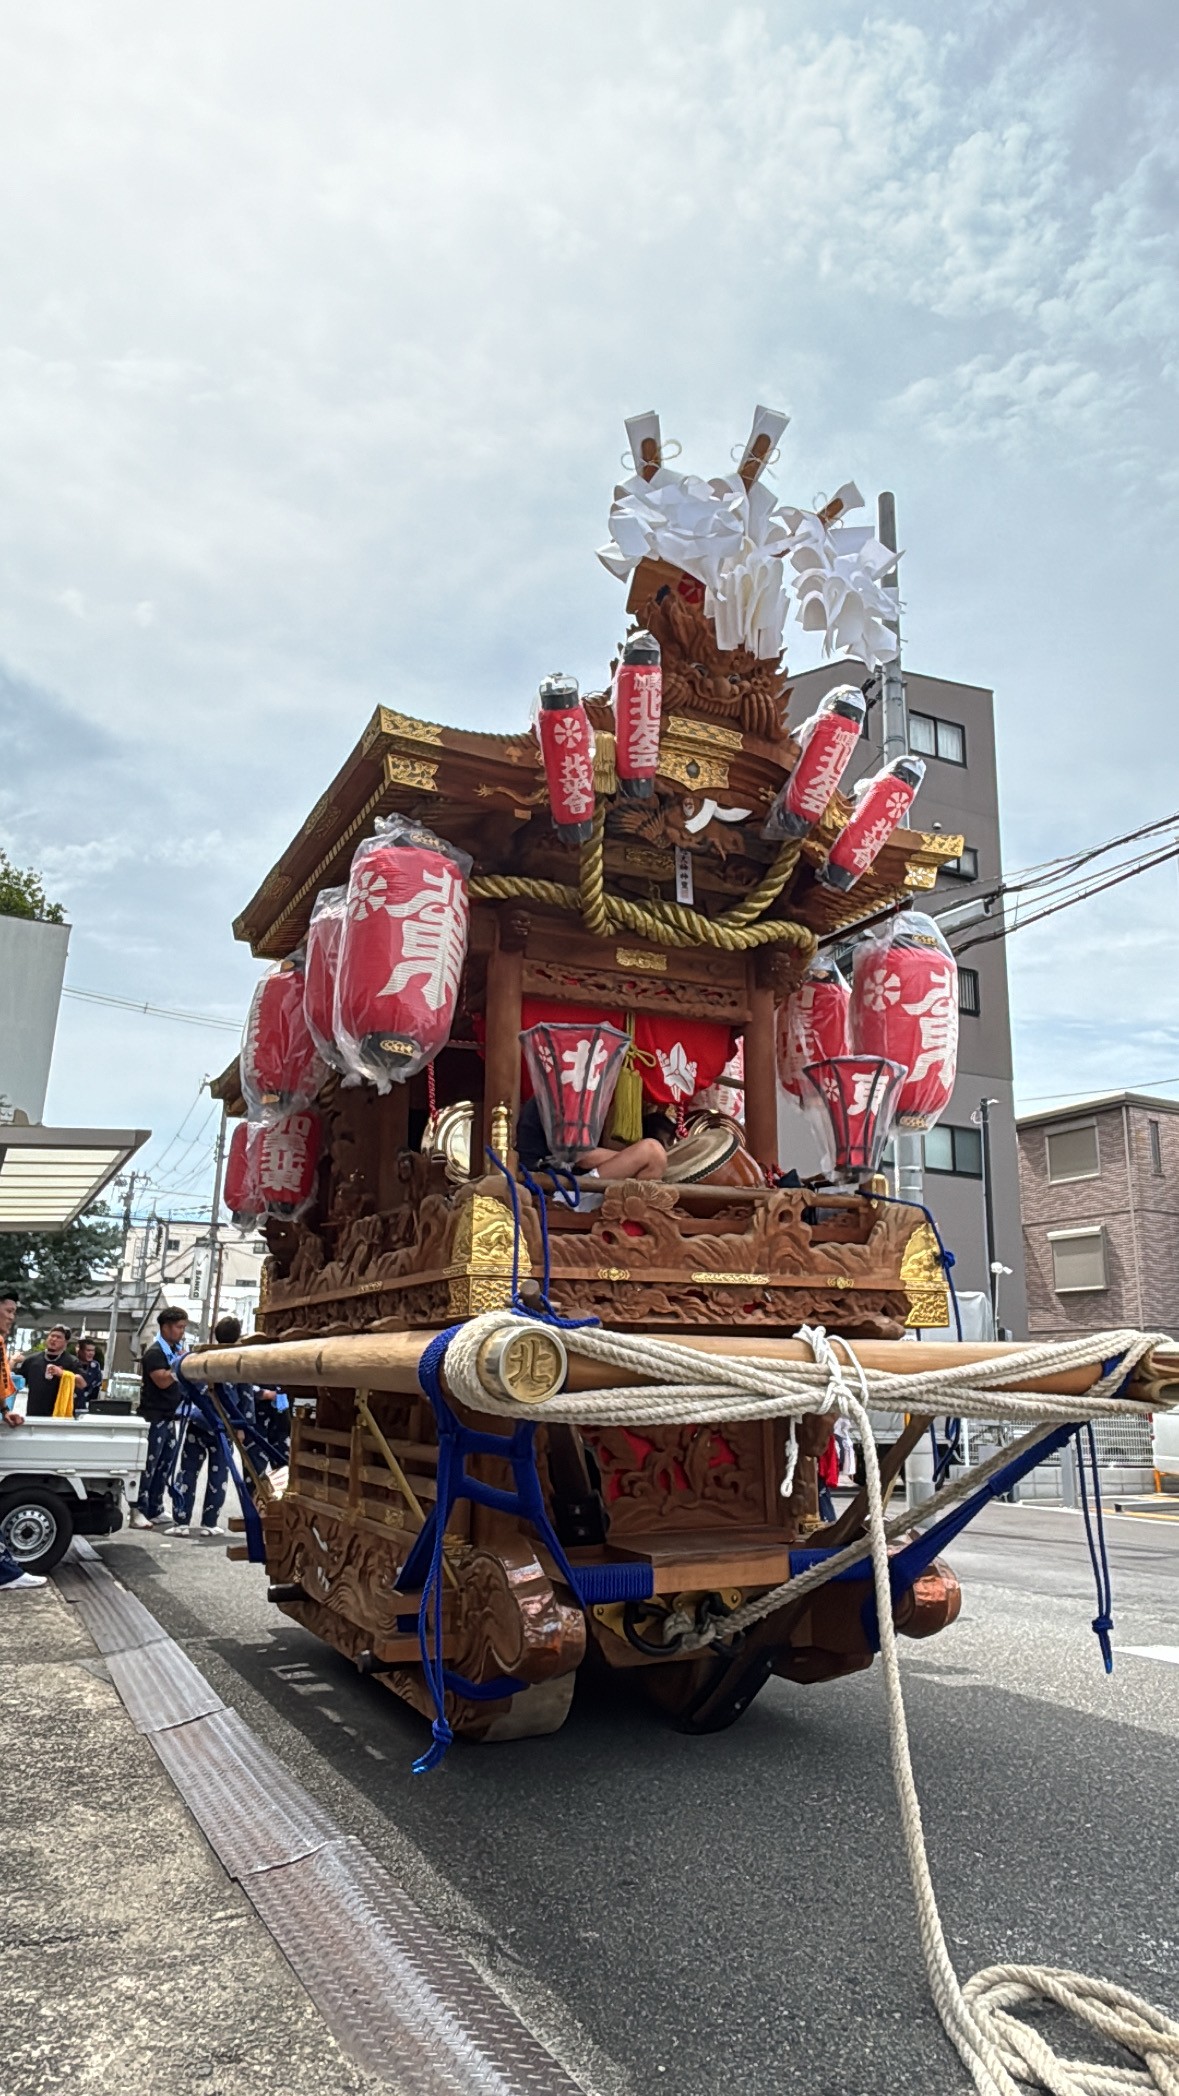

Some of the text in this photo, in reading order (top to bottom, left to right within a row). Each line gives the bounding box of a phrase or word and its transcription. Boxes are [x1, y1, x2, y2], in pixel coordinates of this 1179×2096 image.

[561, 1038, 608, 1092] 北
[847, 1070, 890, 1116] 東
[508, 1341, 556, 1387] 北
